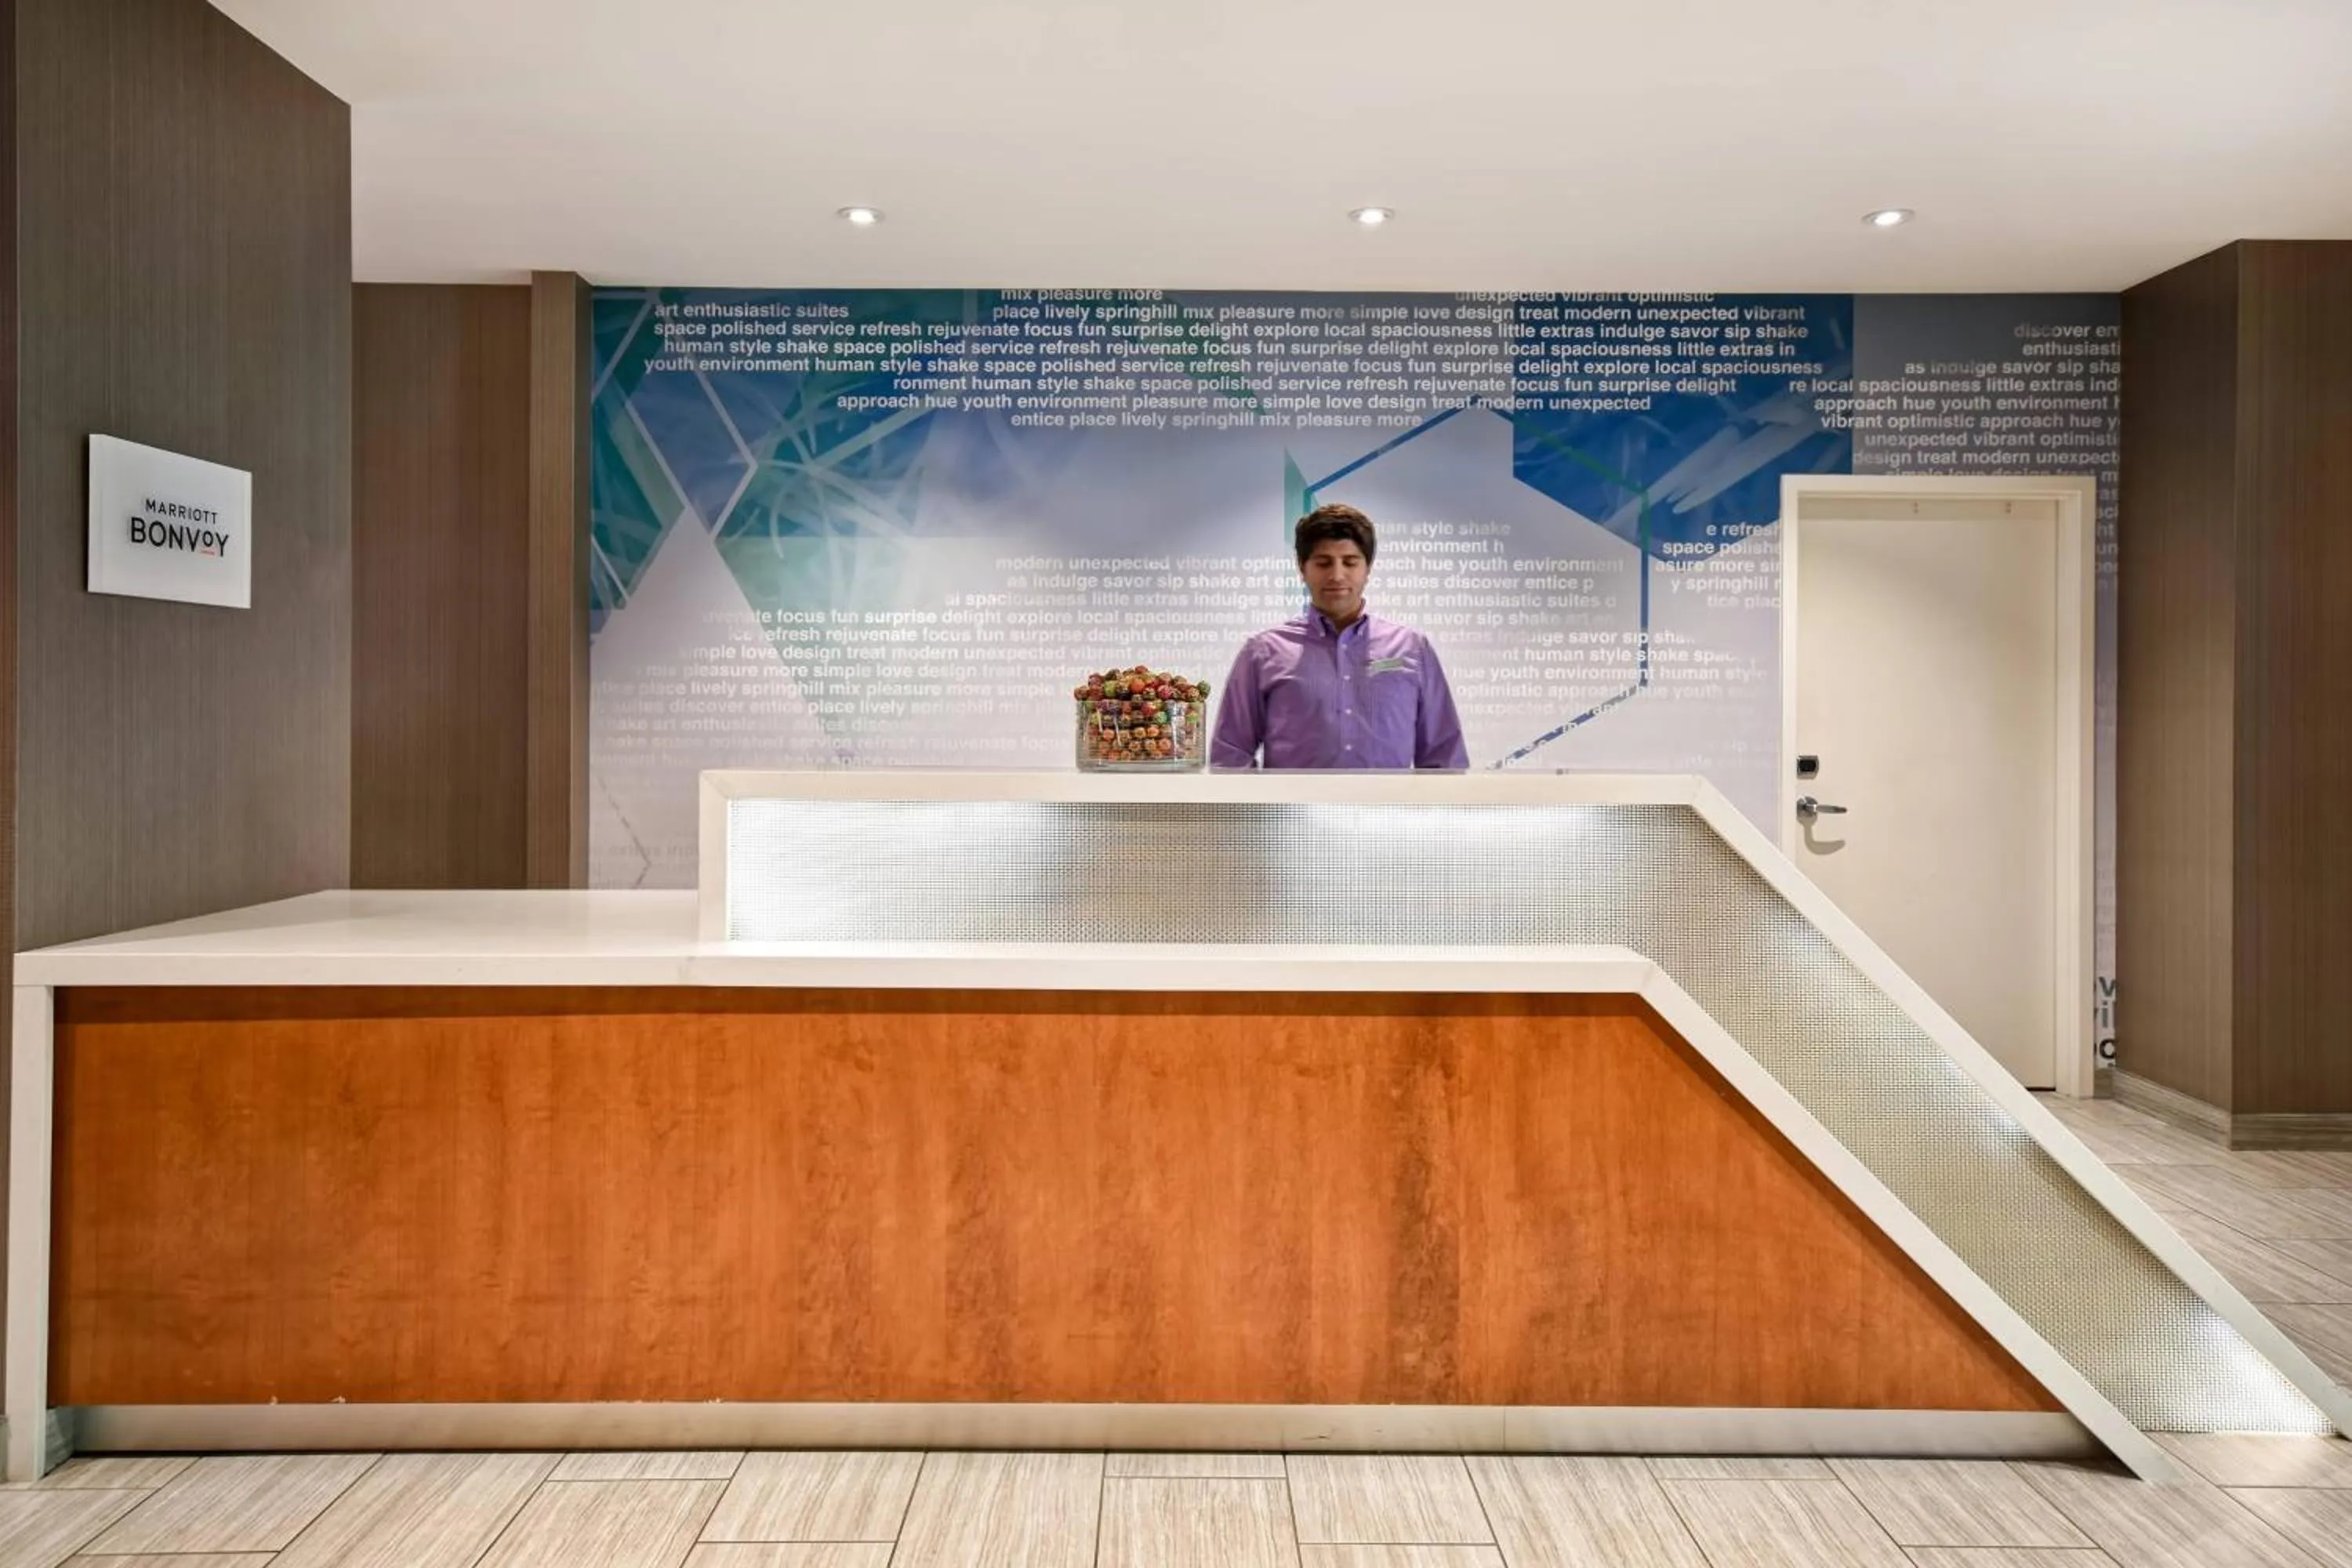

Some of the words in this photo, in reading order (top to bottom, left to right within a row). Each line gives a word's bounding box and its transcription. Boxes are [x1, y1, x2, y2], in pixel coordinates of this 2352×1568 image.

[684, 303, 791, 318] enthusiastic
[796, 303, 849, 318] suites
[1045, 304, 1091, 322] lively
[1095, 304, 1178, 322] springhill
[1183, 304, 1215, 318] mix
[1220, 304, 1295, 322] pleasure
[1455, 305, 1514, 323] design
[1519, 307, 1559, 320] treat
[1637, 306, 1738, 324] unexpected
[712, 321, 786, 339] polished
[792, 321, 855, 336] service
[860, 321, 922, 336] refresh
[927, 321, 1019, 339] rejuvenate
[1023, 322, 1073, 337] focus
[1077, 321, 1106, 336] fun
[1111, 322, 1184, 340] surprise
[1189, 322, 1249, 340] delight
[1254, 322, 1319, 340] explore
[1325, 322, 1365, 337] local
[1371, 322, 1493, 340] spaciousness
[1498, 323, 1535, 338] little
[1541, 325, 1595, 338] extras
[1600, 324, 1665, 342] indulge
[1670, 327, 1719, 338] savor
[1724, 324, 1751, 342] sip
[729, 339, 771, 357] style
[776, 339, 829, 354] shake
[833, 343, 885, 358] space
[891, 339, 965, 358] polished
[971, 339, 1034, 354] service
[1039, 339, 1101, 354] refresh
[1106, 340, 1198, 358] rejuvenate
[1203, 340, 1251, 355] focus
[1256, 340, 1285, 355] fun
[1290, 340, 1363, 358] surprise
[1367, 340, 1428, 358] delight
[1433, 340, 1499, 358] explore
[1504, 341, 1544, 356] local
[1551, 341, 1672, 359] spaciousness
[1678, 342, 1715, 357] little
[1720, 343, 1774, 356] extras
[1780, 342, 1795, 356] in
[699, 357, 810, 372] environment
[815, 357, 875, 372] human
[880, 357, 922, 375] style
[927, 358, 979, 372] shake
[984, 361, 1036, 376] space
[1041, 358, 1116, 376] polished
[1121, 358, 1185, 372] service
[1189, 358, 1251, 373] refresh
[1257, 358, 1348, 376] rejuvenate
[1353, 358, 1403, 373] focus
[1407, 358, 1436, 373] fun
[1441, 358, 1514, 376] surprise
[1519, 359, 1580, 377] delight
[1584, 359, 1650, 377] explore
[1655, 359, 1696, 374] local
[1701, 359, 1823, 377] spaciousness
[1904, 362, 1926, 373] as
[2002, 362, 2053, 373] savor
[2056, 359, 2084, 377] sip
[972, 376, 1032, 390] human
[1036, 376, 1079, 394] style
[1083, 376, 1135, 390] shake
[1140, 379, 1192, 394] space
[1198, 376, 1272, 394] polished
[1278, 376, 1341, 390] service
[1346, 376, 1408, 390] refresh
[1510, 377, 1559, 392] focus
[1564, 377, 1592, 392] fun
[1598, 377, 1671, 395] surprise
[1675, 378, 1737, 396] delight
[1789, 381, 1807, 392] re
[1812, 378, 1853, 393] local
[1859, 377, 1980, 395] spaciousness
[1987, 377, 2025, 392] little
[2030, 378, 2085, 391] extras
[962, 394, 1012, 412] youth
[1017, 394, 1127, 408] environment
[1133, 394, 1208, 412] pleasure
[1263, 394, 1320, 412] simple
[1327, 394, 1363, 409] love
[1367, 394, 1426, 412] design
[1549, 395, 1650, 413] unexpected
[1814, 395, 1897, 413] approach
[1903, 395, 1936, 410] hue
[1940, 395, 1991, 413] youth
[1997, 395, 2108, 410] environment
[1011, 412, 1065, 426] entice
[1069, 412, 1116, 430] place
[1122, 412, 1167, 430] lively
[1297, 412, 1372, 430] pleasure
[1820, 414, 1883, 429] vibrant
[1887, 413, 1975, 431] optimistic
[1980, 413, 2063, 431] approach
[2069, 413, 2102, 428] hue
[1865, 431, 1967, 449] unexpected
[1972, 431, 2036, 446] vibrant
[1916, 450, 1958, 463] treat
[1962, 449, 2030, 464] modern
[145, 497, 219, 524] MARRIOTT
[130, 515, 230, 557] BONVOY
[1412, 520, 1454, 538] style
[1662, 543, 1715, 557] space
[996, 555, 1063, 570] modern
[1069, 555, 1170, 573] unexpected
[1421, 556, 1454, 571] hue
[1457, 557, 1508, 575] youth
[1033, 573, 1098, 591] indulge
[1103, 576, 1152, 587] savor
[1157, 573, 1183, 591] sip
[1189, 573, 1240, 588] shake
[1246, 574, 1270, 587] art
[1386, 574, 1439, 589] suites
[1444, 575, 1520, 590] discover
[1525, 575, 1578, 590] entice
[1092, 591, 1130, 606] little
[1194, 591, 1259, 609] indulge
[1406, 593, 1431, 606] art
[1435, 593, 1543, 608] enthusiastic
[1547, 593, 1600, 608] suites
[776, 608, 826, 623] focus
[830, 608, 858, 623] fun
[864, 608, 937, 626] surprise
[942, 609, 1003, 627] delight
[1007, 609, 1073, 627] explore
[1078, 609, 1119, 624] local
[1123, 609, 1246, 627] spaciousness
[826, 626, 916, 644] rejuvenate
[922, 627, 971, 642] focus
[976, 627, 1004, 642] fun
[1009, 627, 1083, 645] surprise
[1087, 627, 1148, 645] delight
[1152, 627, 1218, 645] explore
[1569, 632, 1617, 643] savor
[782, 644, 841, 662] design
[846, 645, 887, 659] treat
[964, 645, 1065, 663] unexpected
[1525, 647, 1584, 662] human
[1589, 647, 1632, 665] style
[813, 662, 871, 681] simple
[877, 662, 913, 677] love
[917, 663, 977, 681] design
[1489, 664, 1539, 682] youth
[1660, 665, 1719, 680] human
[691, 680, 737, 698] lively
[829, 681, 862, 695] mix
[866, 681, 942, 699] pleasure
[808, 699, 855, 717] place
[860, 699, 906, 717] lively
